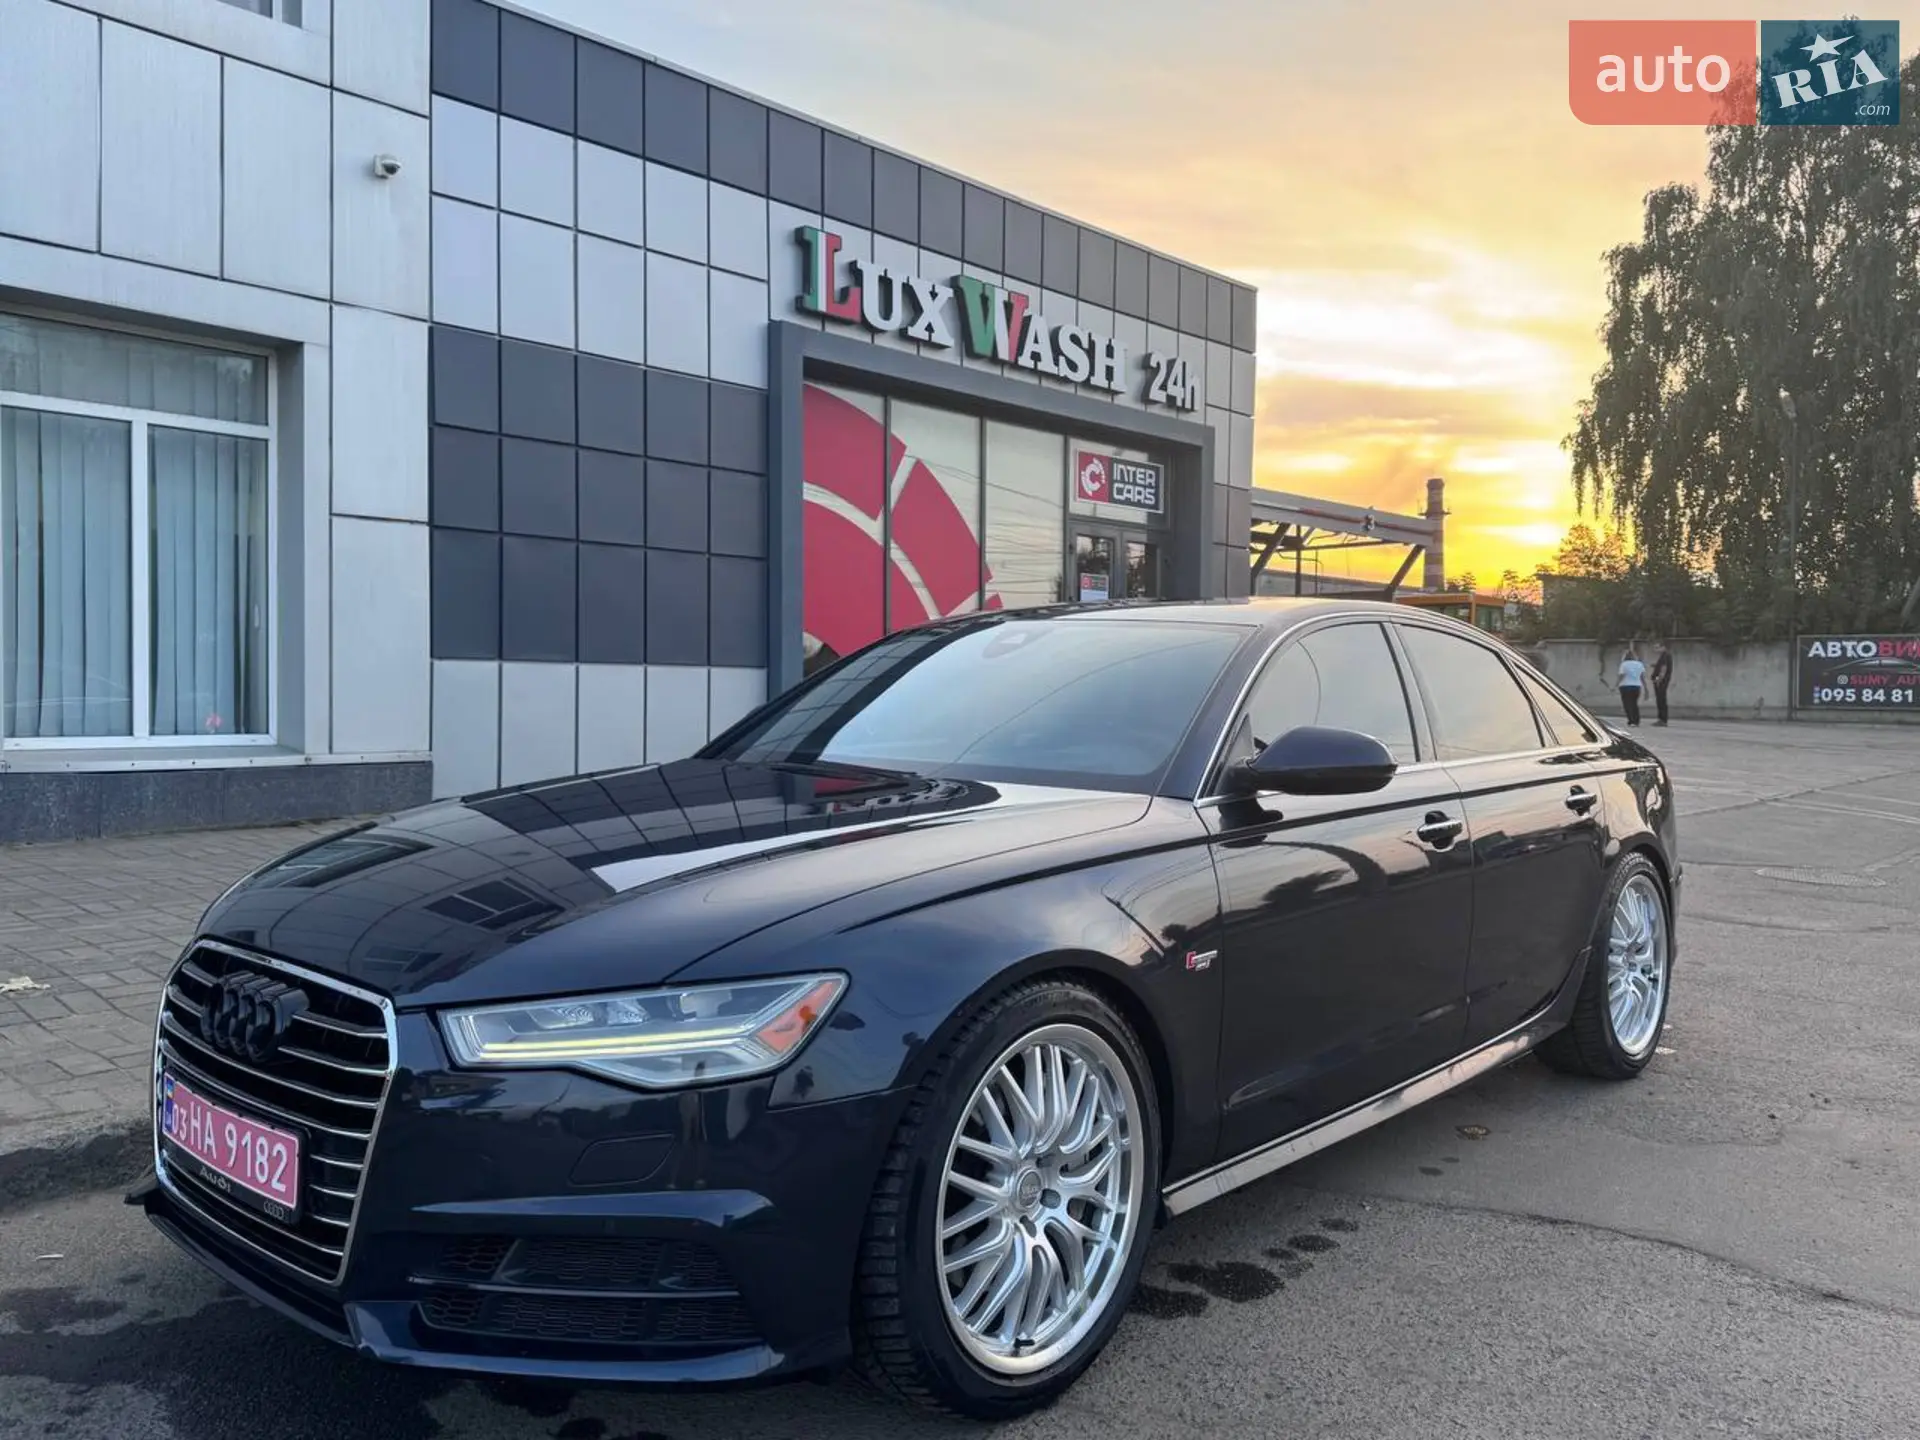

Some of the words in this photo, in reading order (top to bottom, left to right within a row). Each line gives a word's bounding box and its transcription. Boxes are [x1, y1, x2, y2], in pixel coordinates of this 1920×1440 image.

[1113, 462, 1156, 487] INTER
[1113, 483, 1156, 505] CARS
[1821, 688, 1857, 702] 095
[1862, 688, 1887, 703] 84
[1891, 688, 1914, 703] 81
[224, 1121, 288, 1194] 9182
